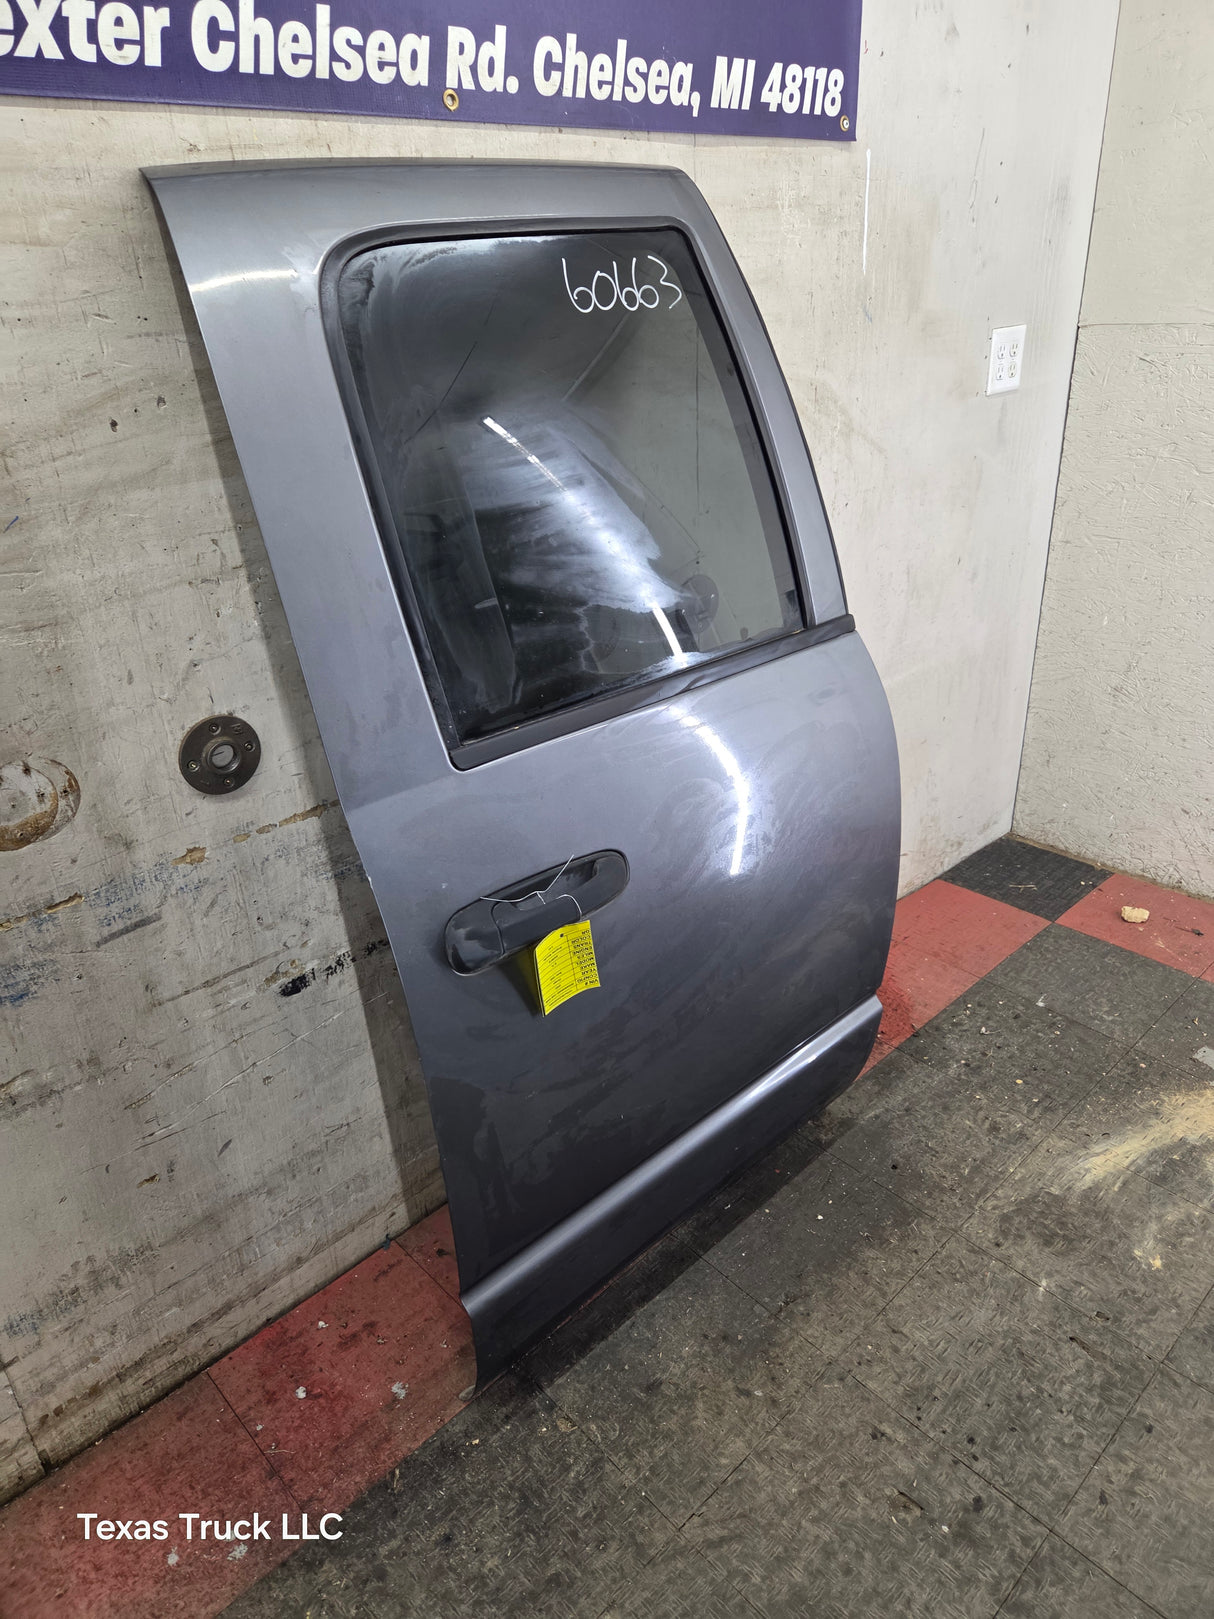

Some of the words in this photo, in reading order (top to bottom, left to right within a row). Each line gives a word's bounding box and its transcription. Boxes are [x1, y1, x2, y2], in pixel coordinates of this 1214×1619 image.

[191, 0, 430, 87] Chelsea
[445, 24, 519, 94] Rd.
[533, 33, 701, 117] Chelsea,
[710, 55, 756, 111] MI
[760, 62, 845, 117] 48118
